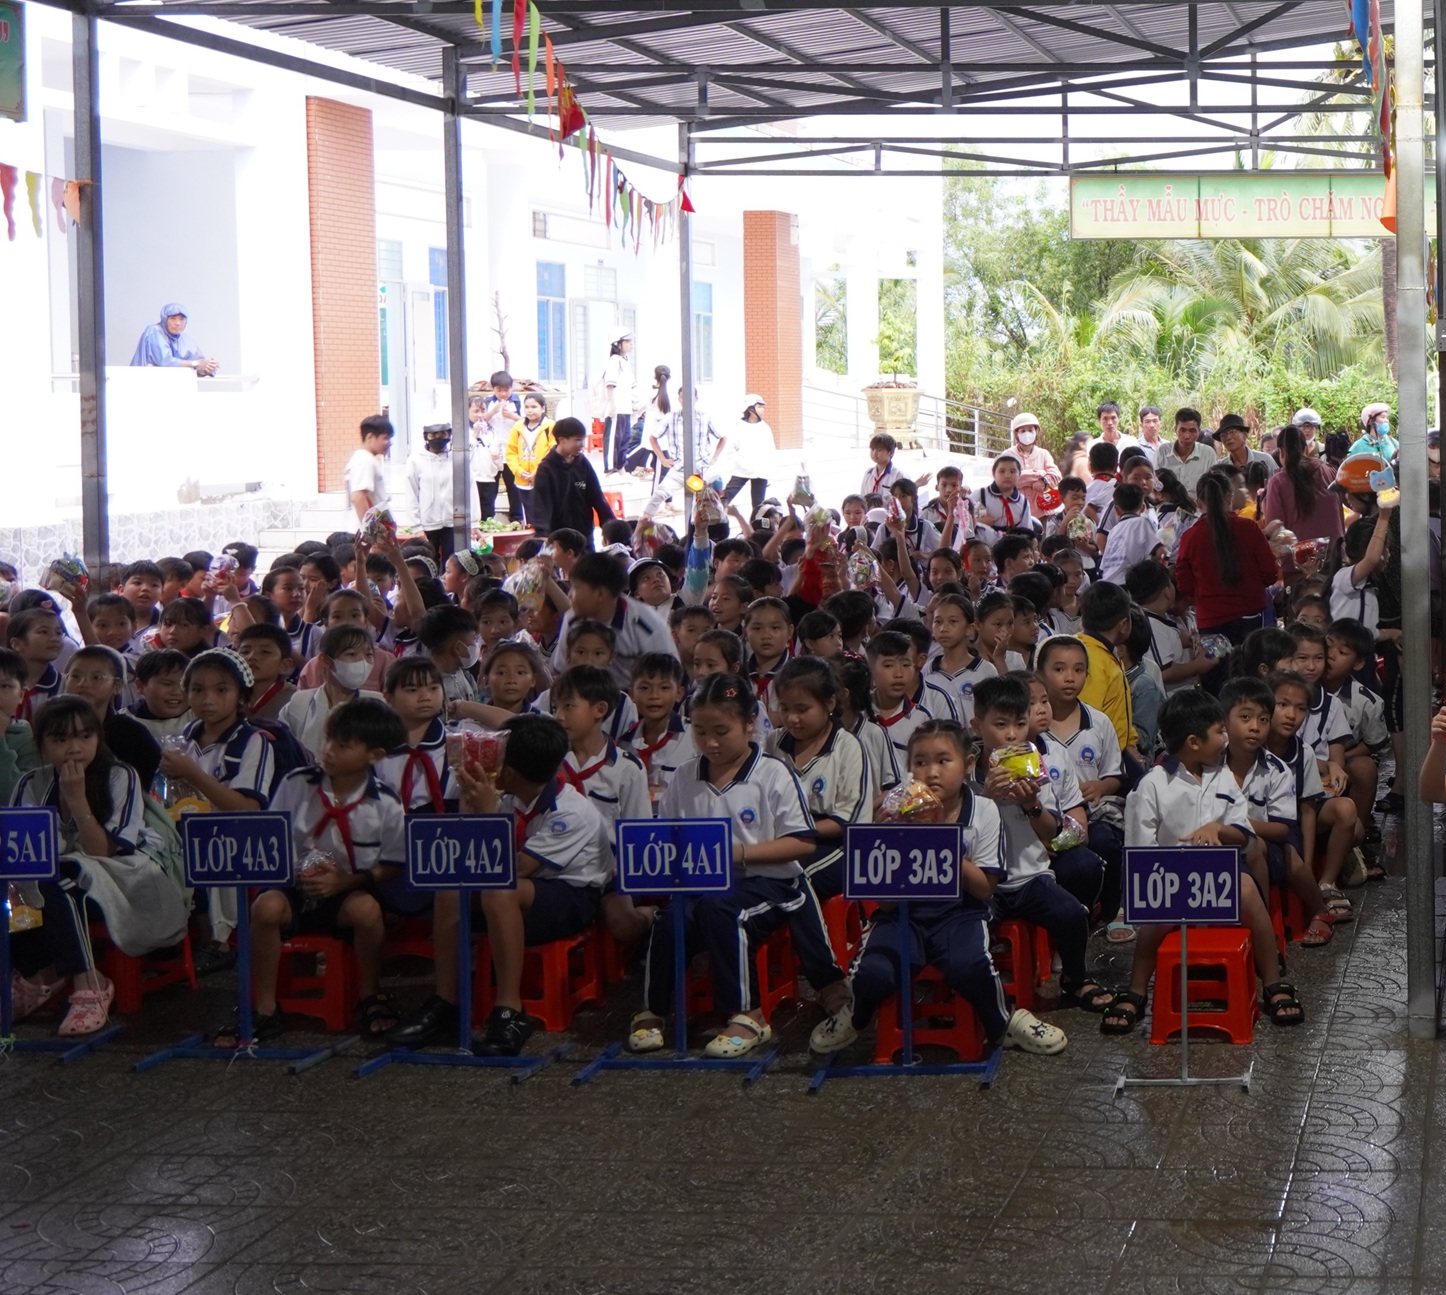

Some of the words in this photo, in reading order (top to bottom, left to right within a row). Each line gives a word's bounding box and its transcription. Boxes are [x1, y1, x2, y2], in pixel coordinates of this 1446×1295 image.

[1147, 184, 1188, 222] MẪU
[1194, 193, 1236, 227] MỰC
[1254, 190, 1291, 222] TRÒ
[1299, 190, 1354, 221] CHĂM
[7, 830, 49, 863] 5A1
[193, 826, 238, 872] LỚP
[242, 836, 280, 871] 4A3
[415, 828, 461, 874] LỚP
[464, 838, 503, 874] 4A2
[626, 833, 677, 876] LỚP
[681, 842, 724, 875] 4A1
[853, 840, 902, 885] LỚP
[908, 848, 954, 885] 3A3
[1133, 863, 1180, 908] LỚP
[1187, 871, 1232, 908] 3A2
